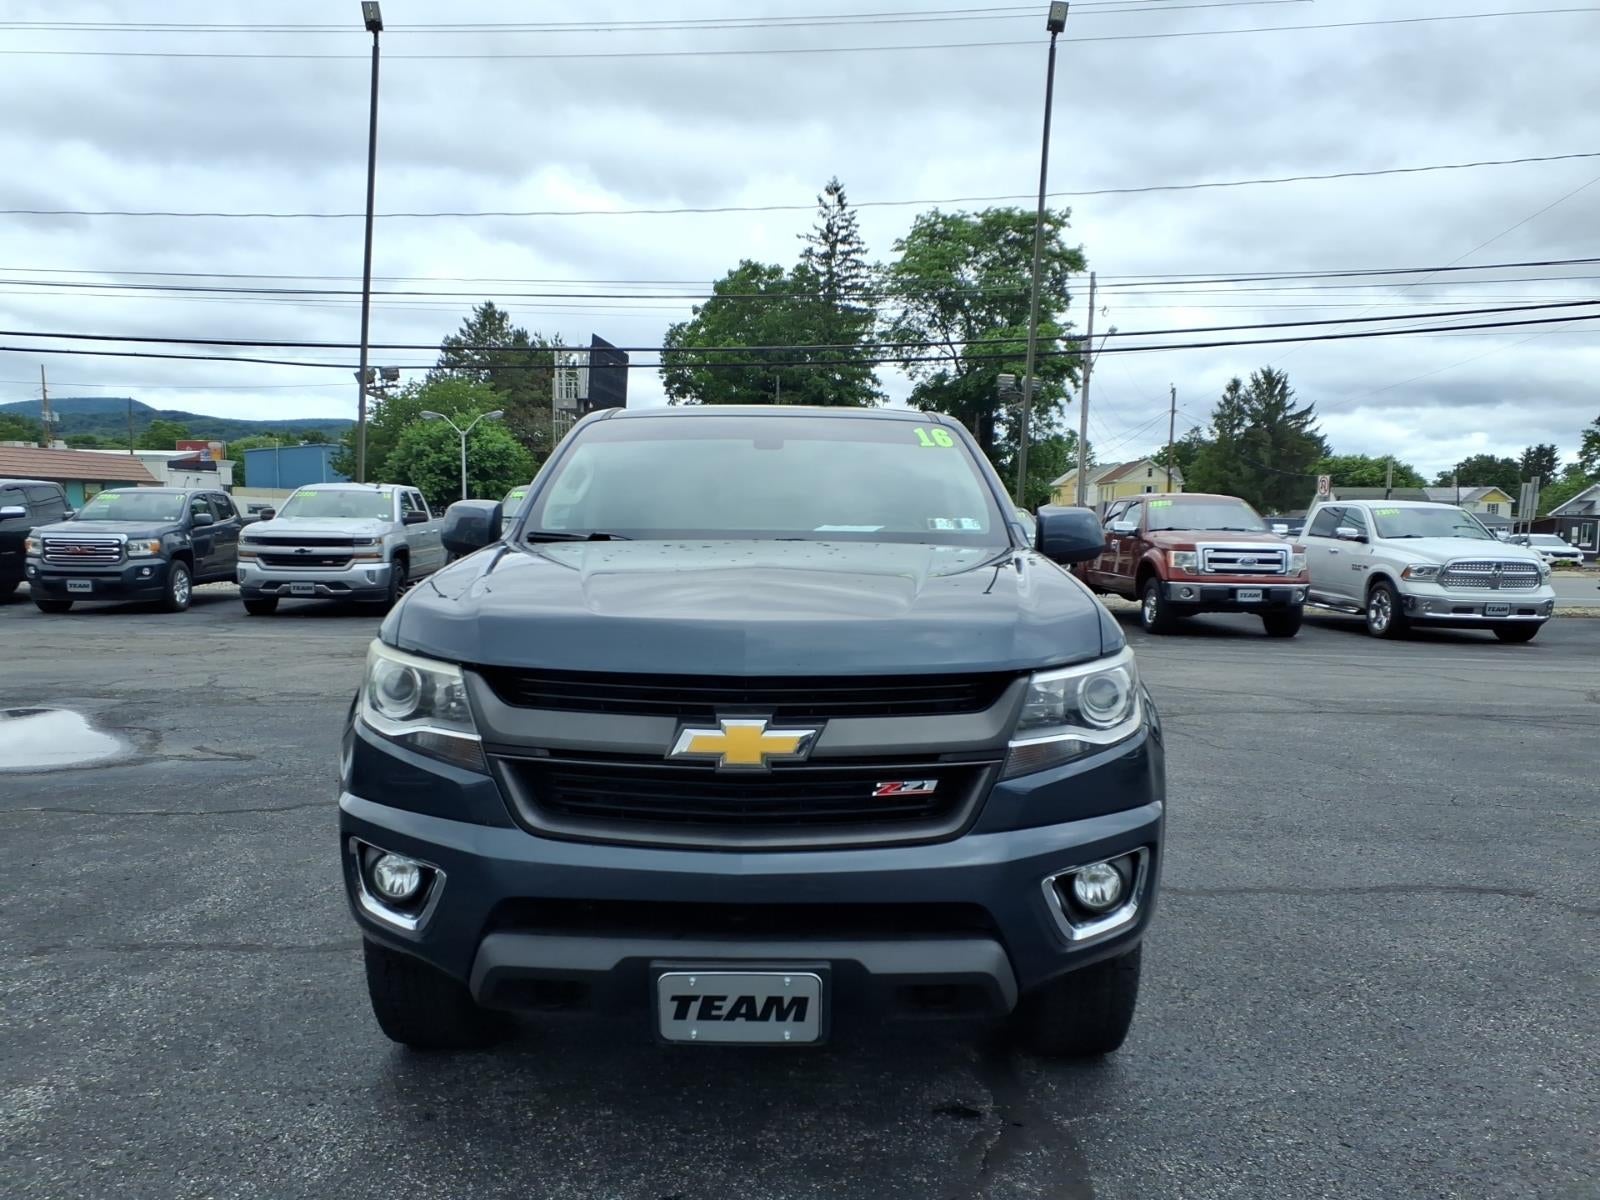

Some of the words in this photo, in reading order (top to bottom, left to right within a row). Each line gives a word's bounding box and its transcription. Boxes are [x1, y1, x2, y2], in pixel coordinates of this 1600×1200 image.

[913, 427, 954, 448] 16
[872, 779, 938, 797] Z71
[670, 995, 810, 1022] TEAM
